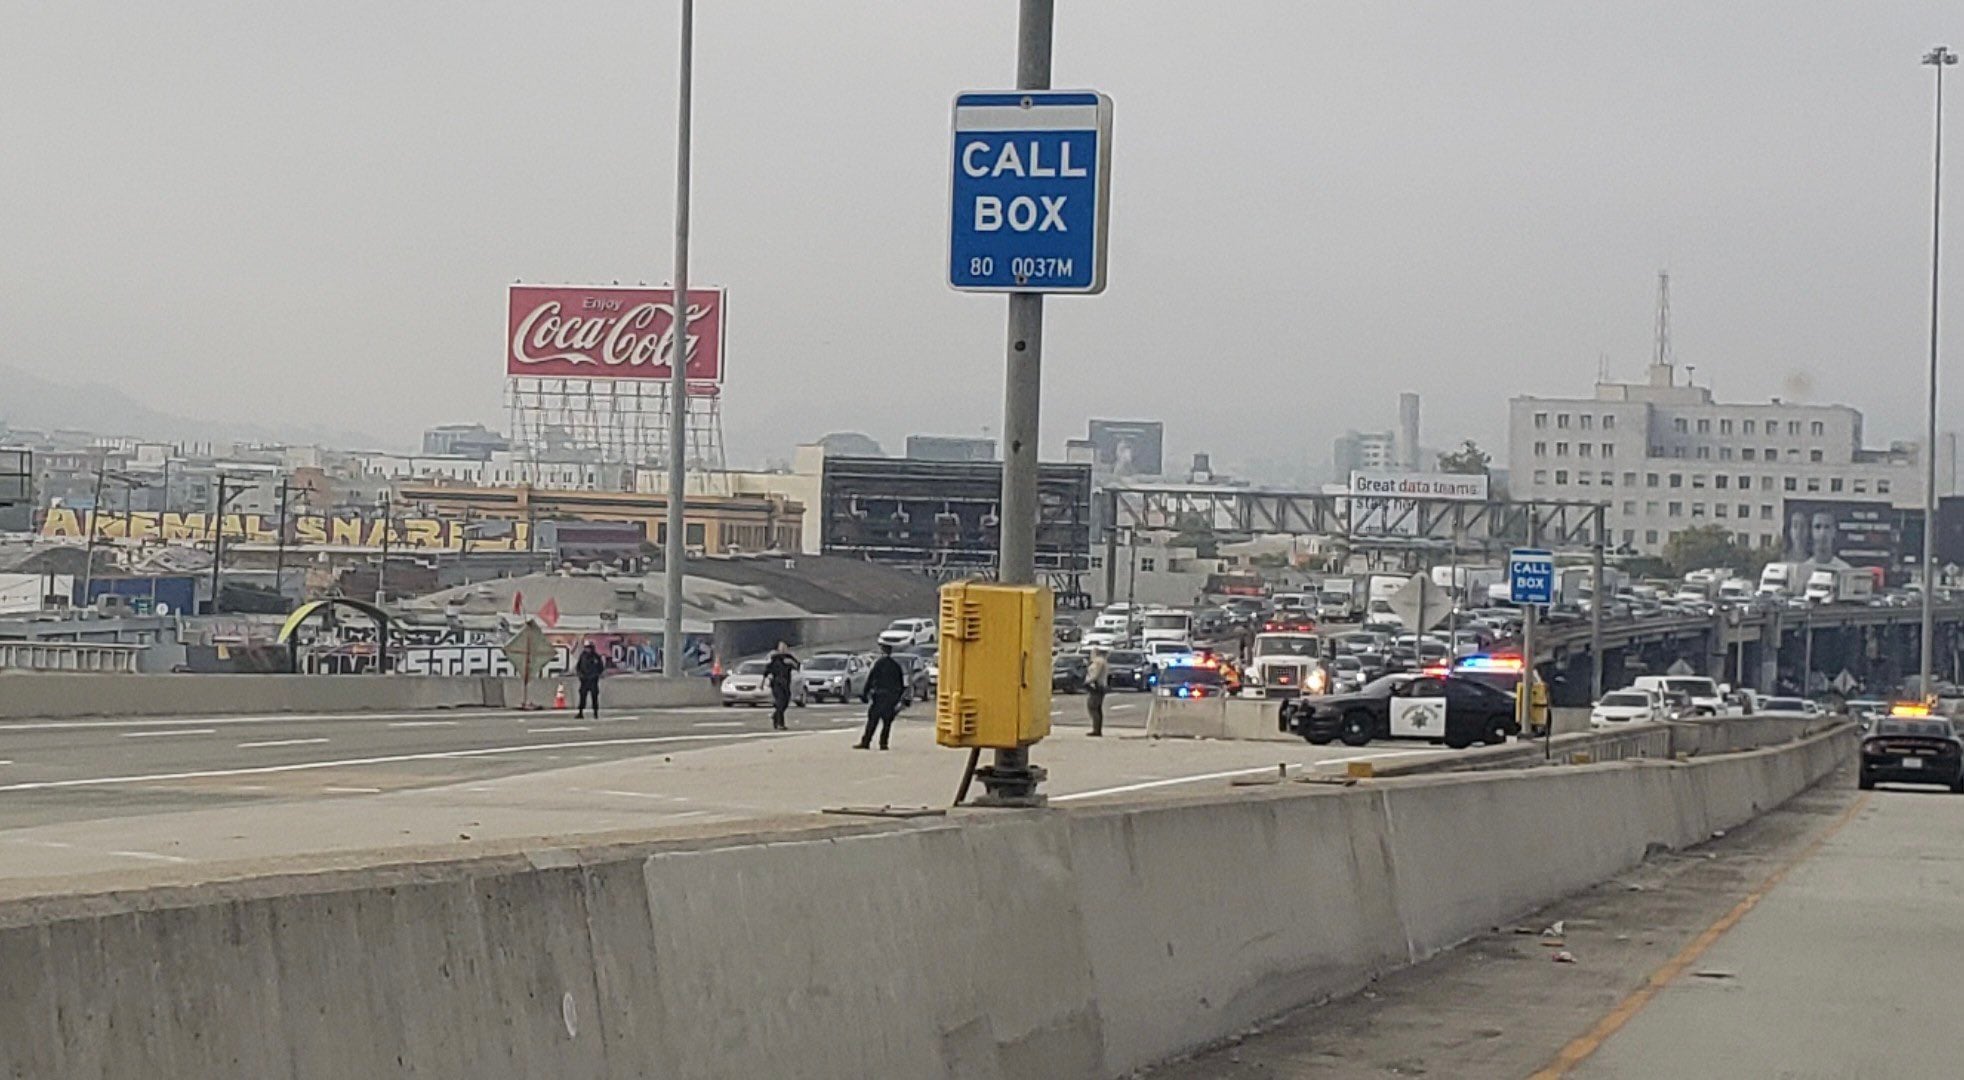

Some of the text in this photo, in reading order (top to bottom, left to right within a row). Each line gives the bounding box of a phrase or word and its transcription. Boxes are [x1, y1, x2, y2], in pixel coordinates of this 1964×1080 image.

[962, 141, 1088, 178] CALL
[974, 195, 1068, 232] BOX
[970, 256, 1073, 277] 80 0037M
[583, 296, 624, 312] Enjoy
[1357, 477, 1396, 492] Great
[1513, 562, 1550, 575] CALL
[1516, 576, 1545, 589] BOX
